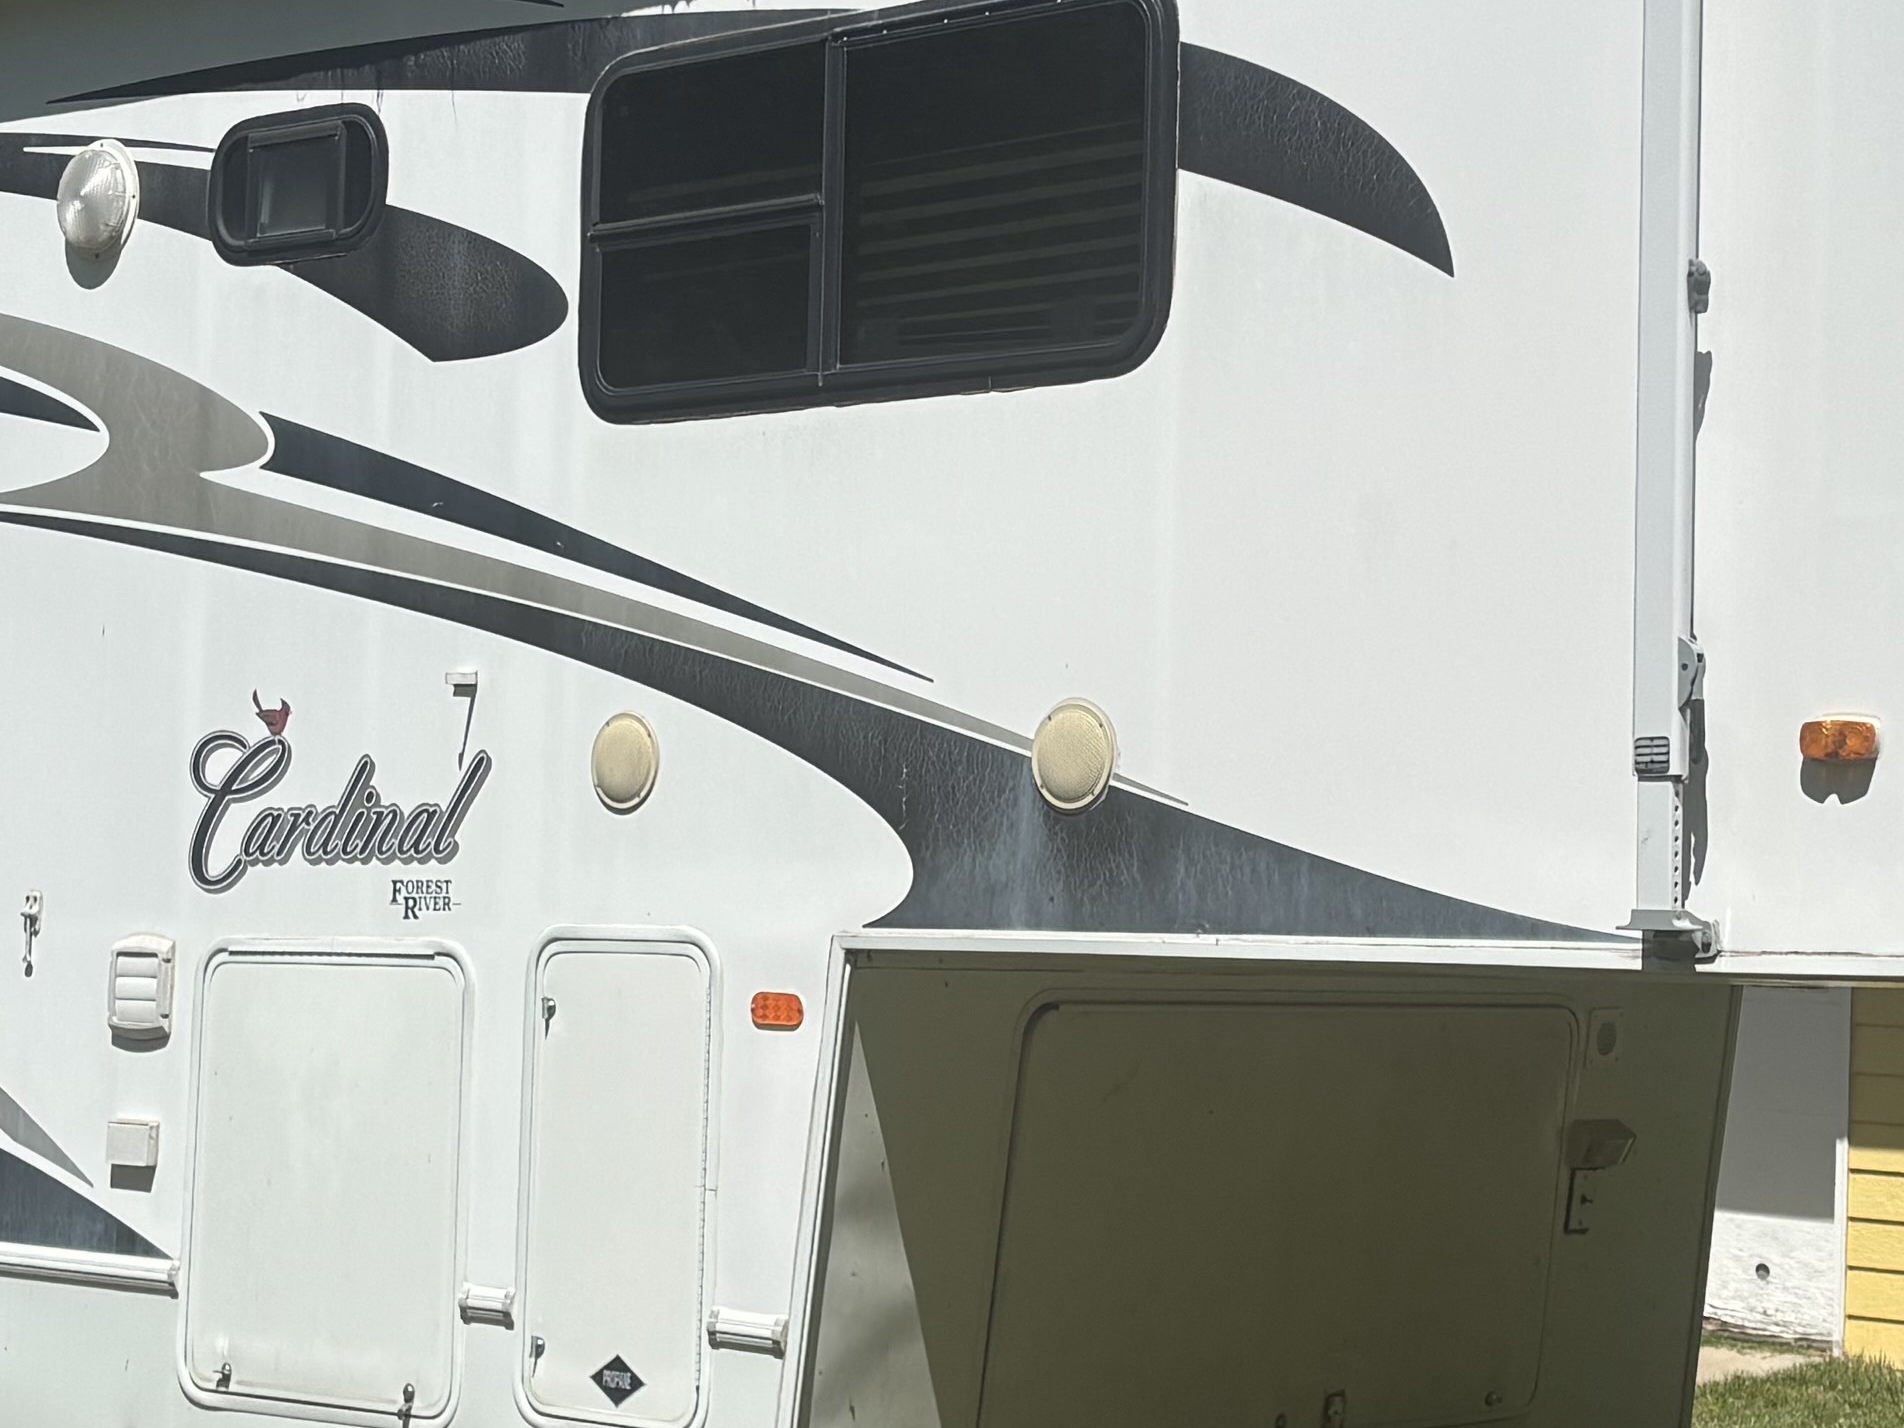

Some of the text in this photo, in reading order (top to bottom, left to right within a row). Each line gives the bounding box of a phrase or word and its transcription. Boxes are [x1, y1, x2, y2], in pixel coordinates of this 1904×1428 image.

[189, 730, 492, 894] Cardinal
[391, 879, 452, 903] FOREST
[402, 896, 452, 920] RIVER
